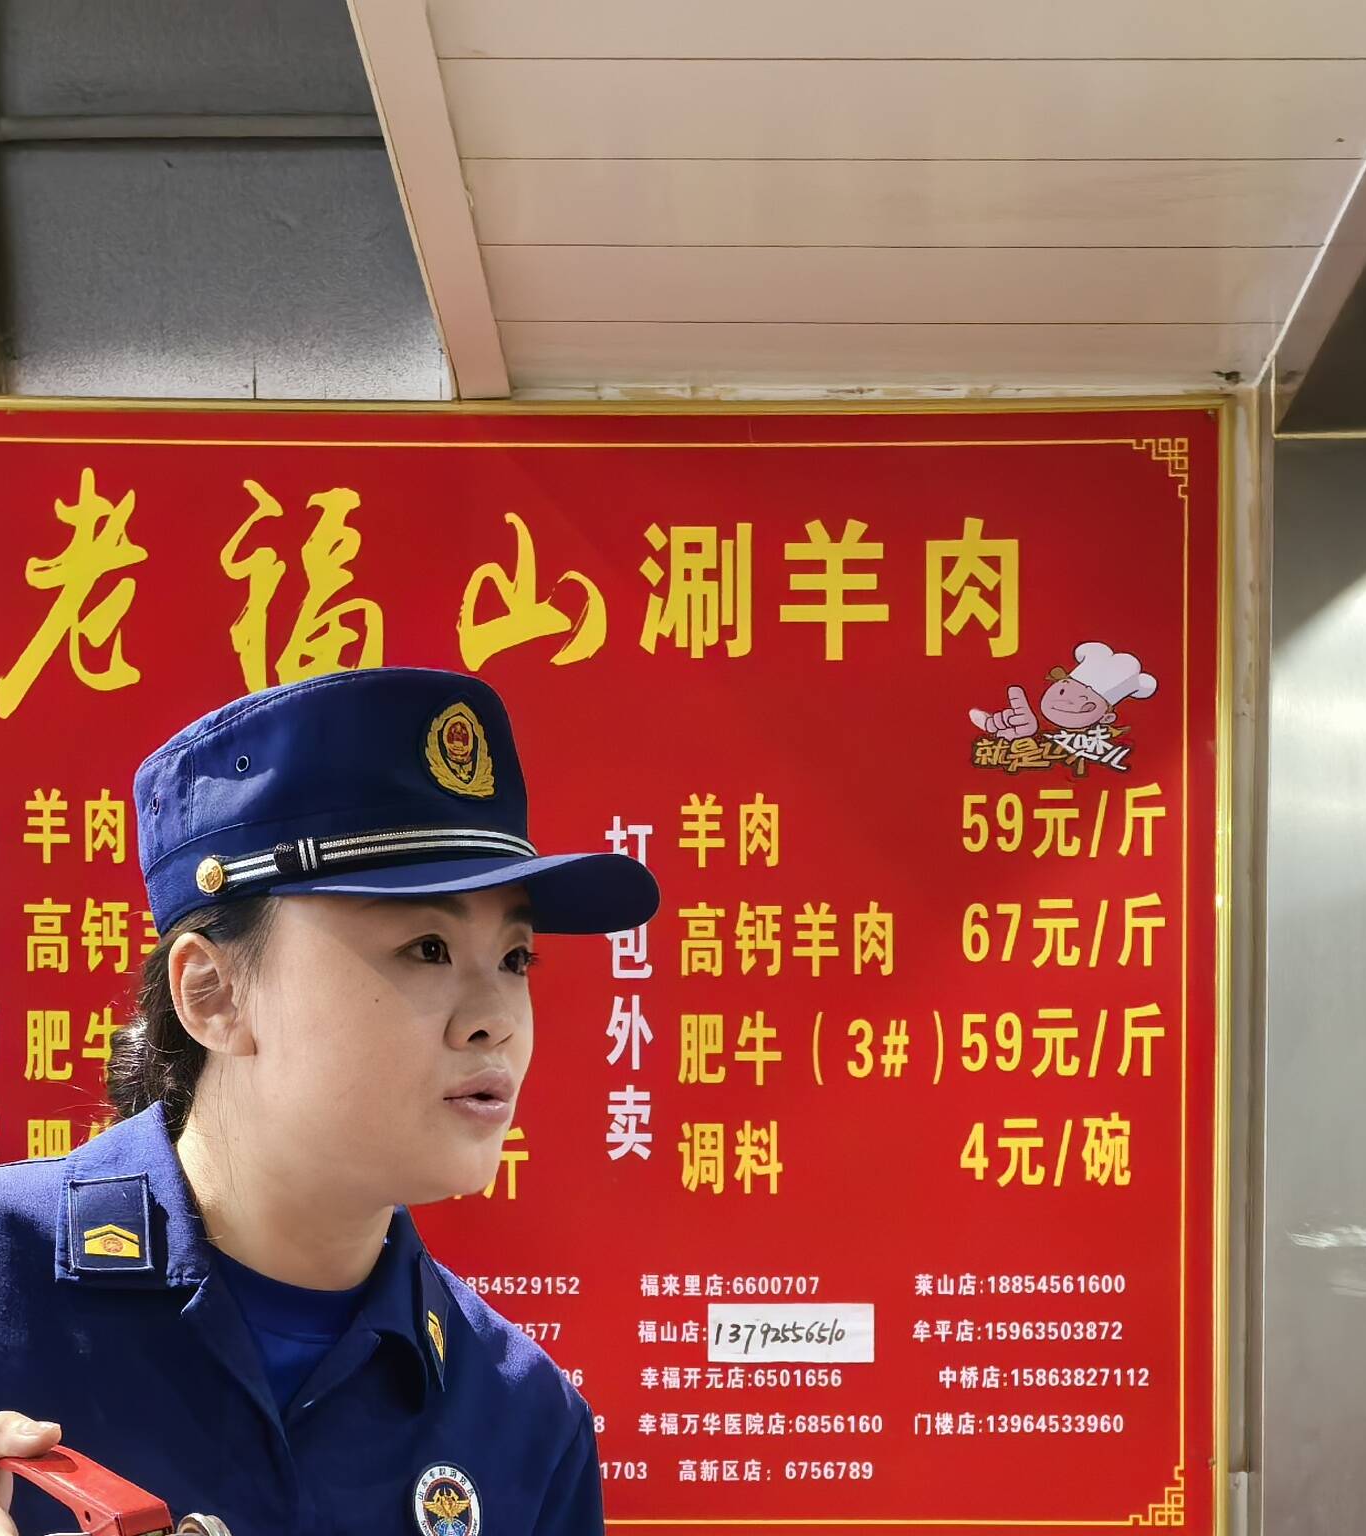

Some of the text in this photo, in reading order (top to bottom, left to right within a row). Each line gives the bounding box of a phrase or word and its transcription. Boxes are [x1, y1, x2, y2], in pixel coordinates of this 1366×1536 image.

[23, 788, 127, 865] 羊肉
[678, 782, 1166, 868] 羊肉 59元/斤
[678, 892, 1166, 977] 高钙羊肉 67元/斤
[961, 1002, 1166, 1078] 59元/斤
[678, 1111, 1132, 1195] 调料 4元/碗
[640, 1273, 820, 1297] 福来里店:6600707
[914, 1272, 1126, 1297] 莱山店:18854561600
[912, 1318, 1123, 1343] 牟平店:15963503872
[640, 1365, 843, 1390] 幸福开元店:6501656
[938, 1365, 1150, 1390] 中桥店:15863827112
[637, 1411, 884, 1436] 幸福万华医院店:6856160
[913, 1411, 1125, 1437] 门楼店:13964533960
